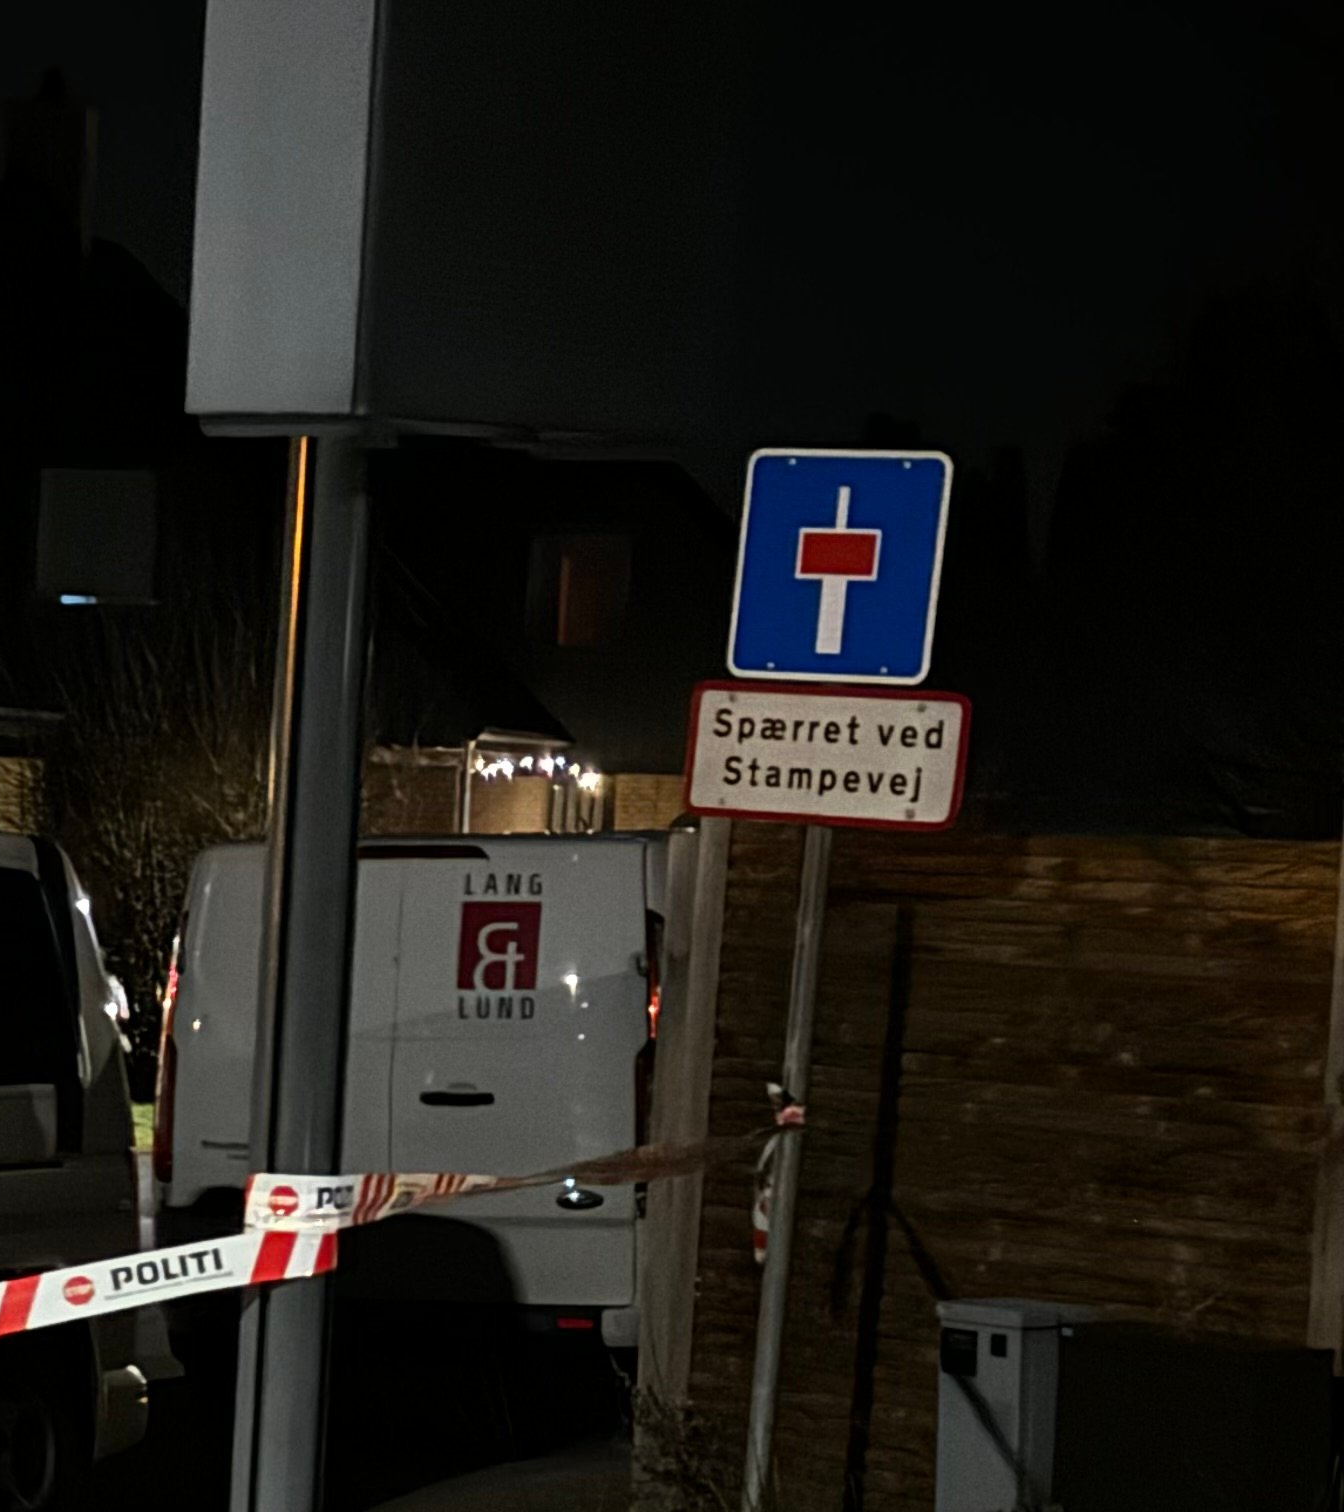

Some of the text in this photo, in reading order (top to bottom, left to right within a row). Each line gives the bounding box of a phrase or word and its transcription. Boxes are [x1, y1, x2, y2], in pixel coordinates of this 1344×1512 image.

[712, 707, 946, 750] Spærret ved
[721, 755, 924, 804] Stampevej
[463, 872, 543, 896] LANG
[457, 996, 536, 1020] LUND
[110, 1247, 224, 1291] POLITI
